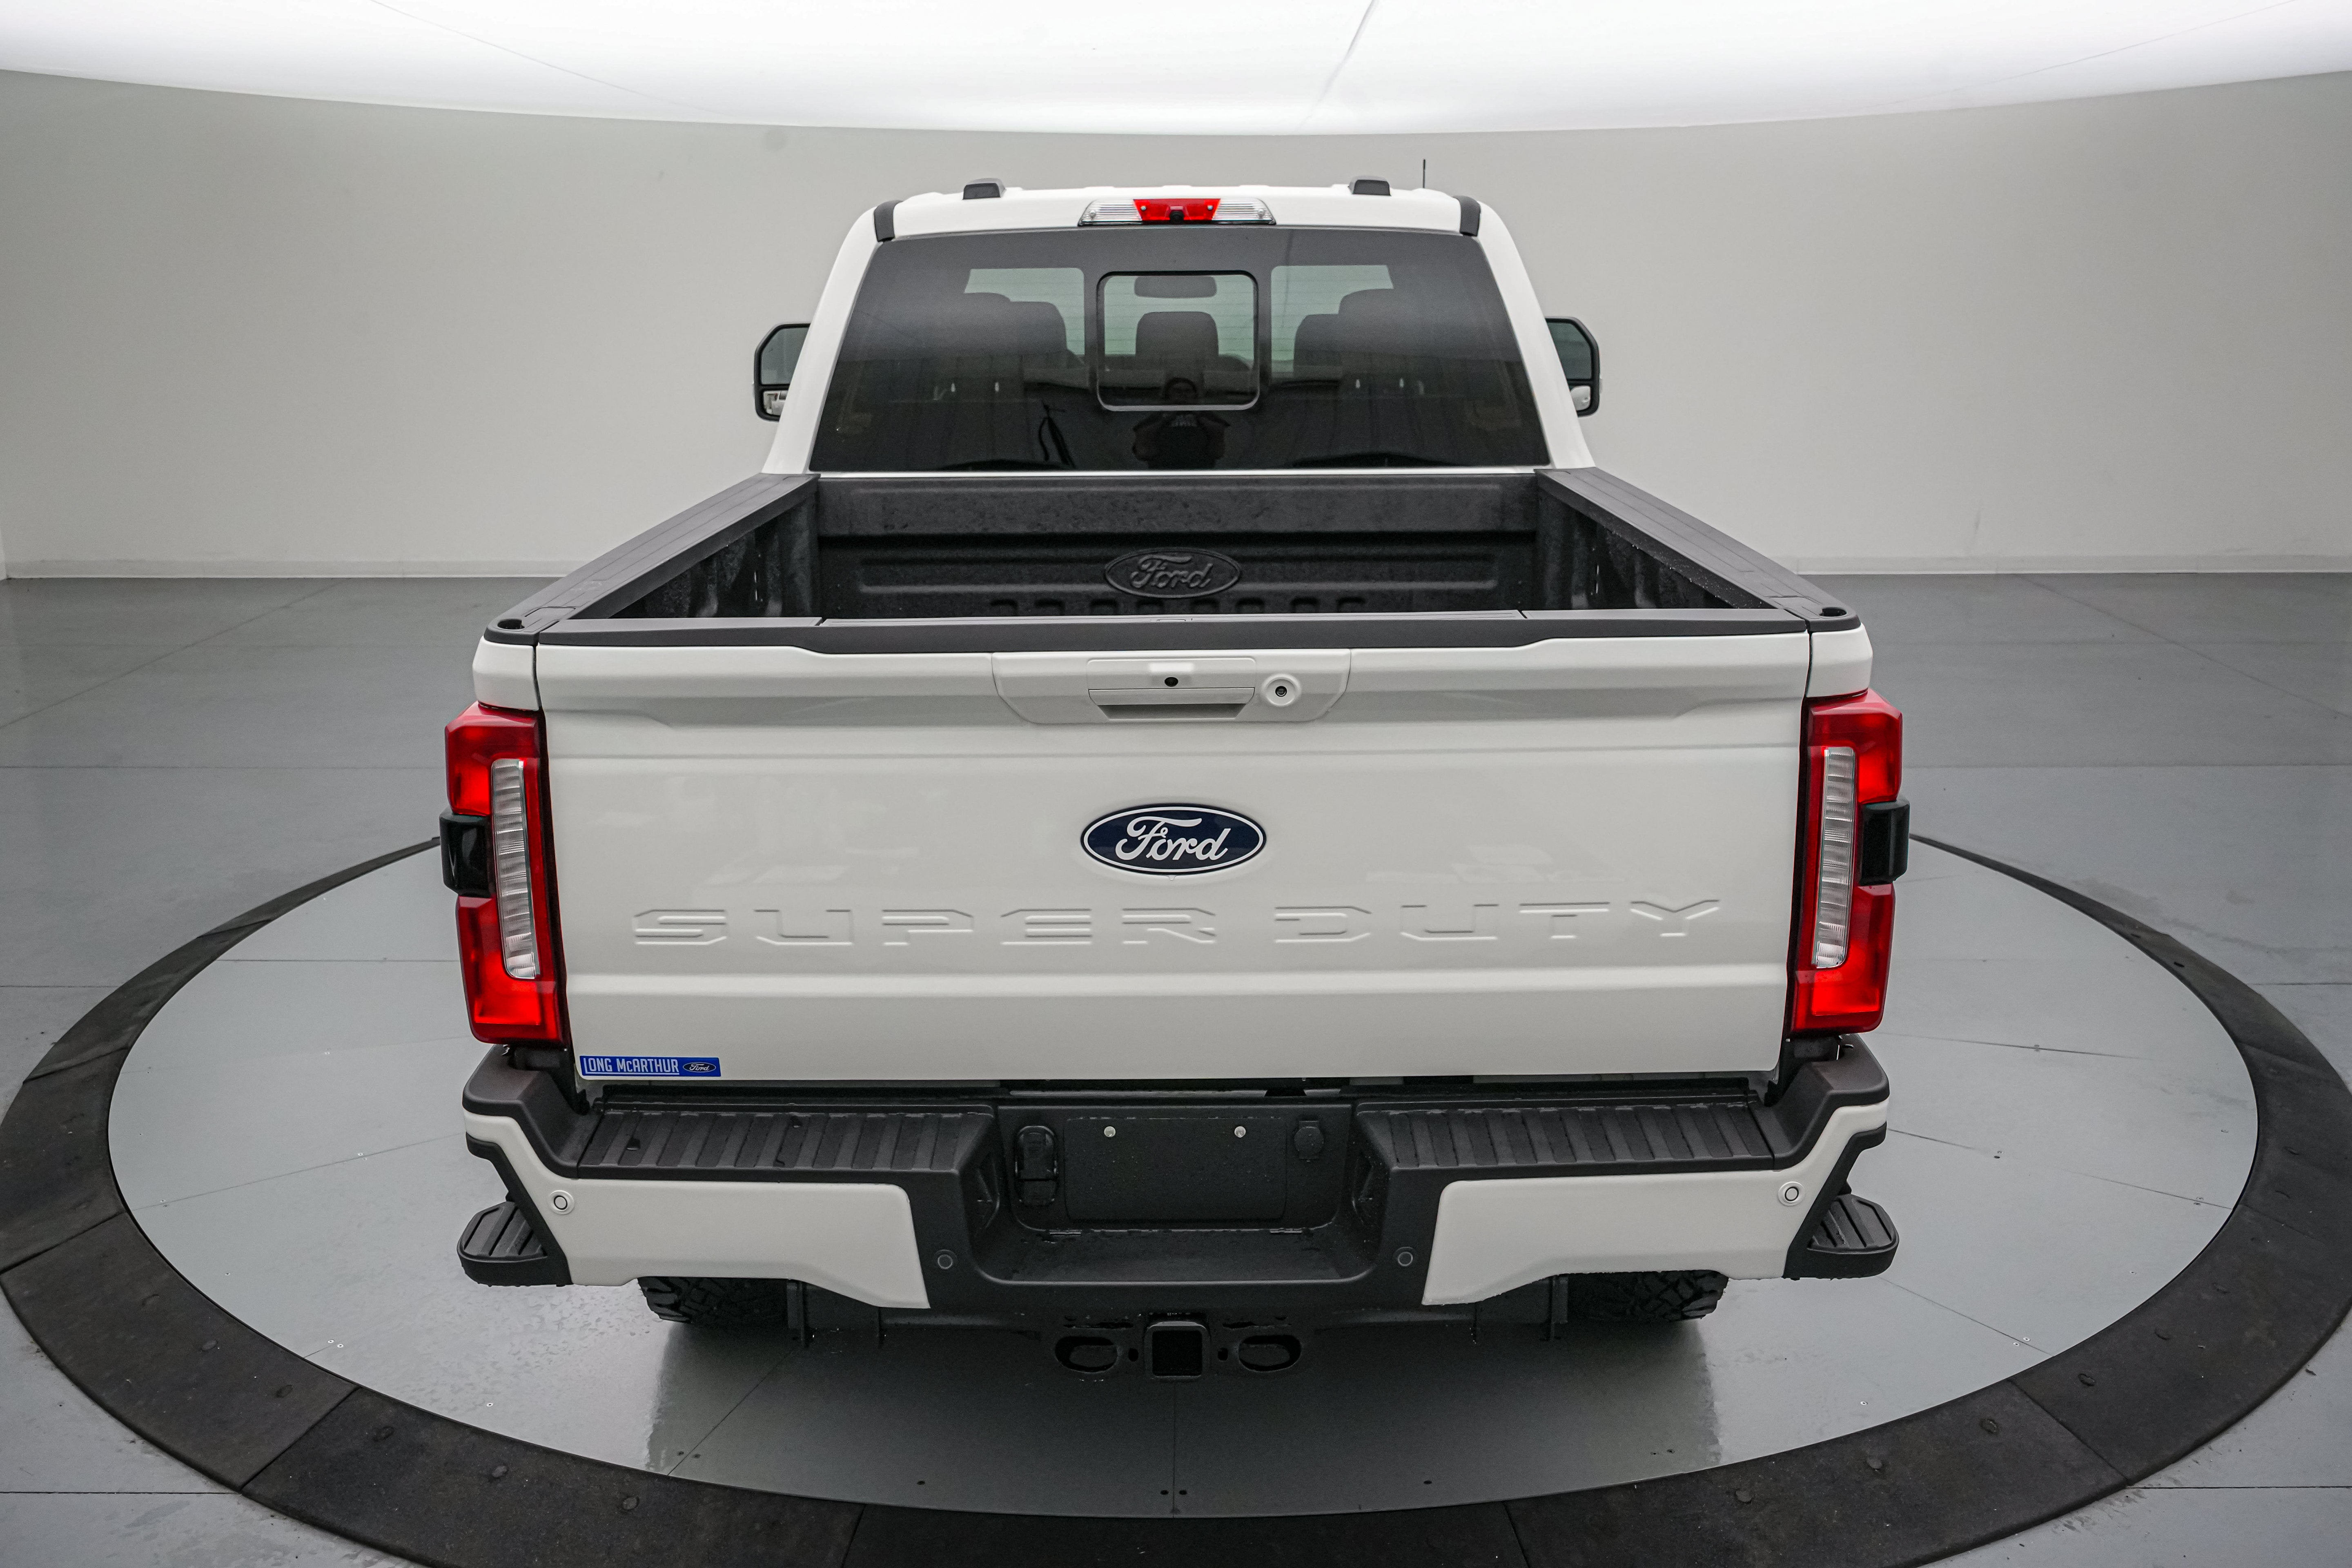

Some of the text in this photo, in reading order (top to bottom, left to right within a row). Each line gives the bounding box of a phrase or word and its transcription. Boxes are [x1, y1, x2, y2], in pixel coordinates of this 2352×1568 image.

[1130, 555, 1213, 589] Ford
[1115, 816, 1231, 860] Ford
[633, 899, 1719, 945] SUPER DUTY
[583, 1058, 612, 1074] LONG
[689, 1062, 710, 1072] Ford
